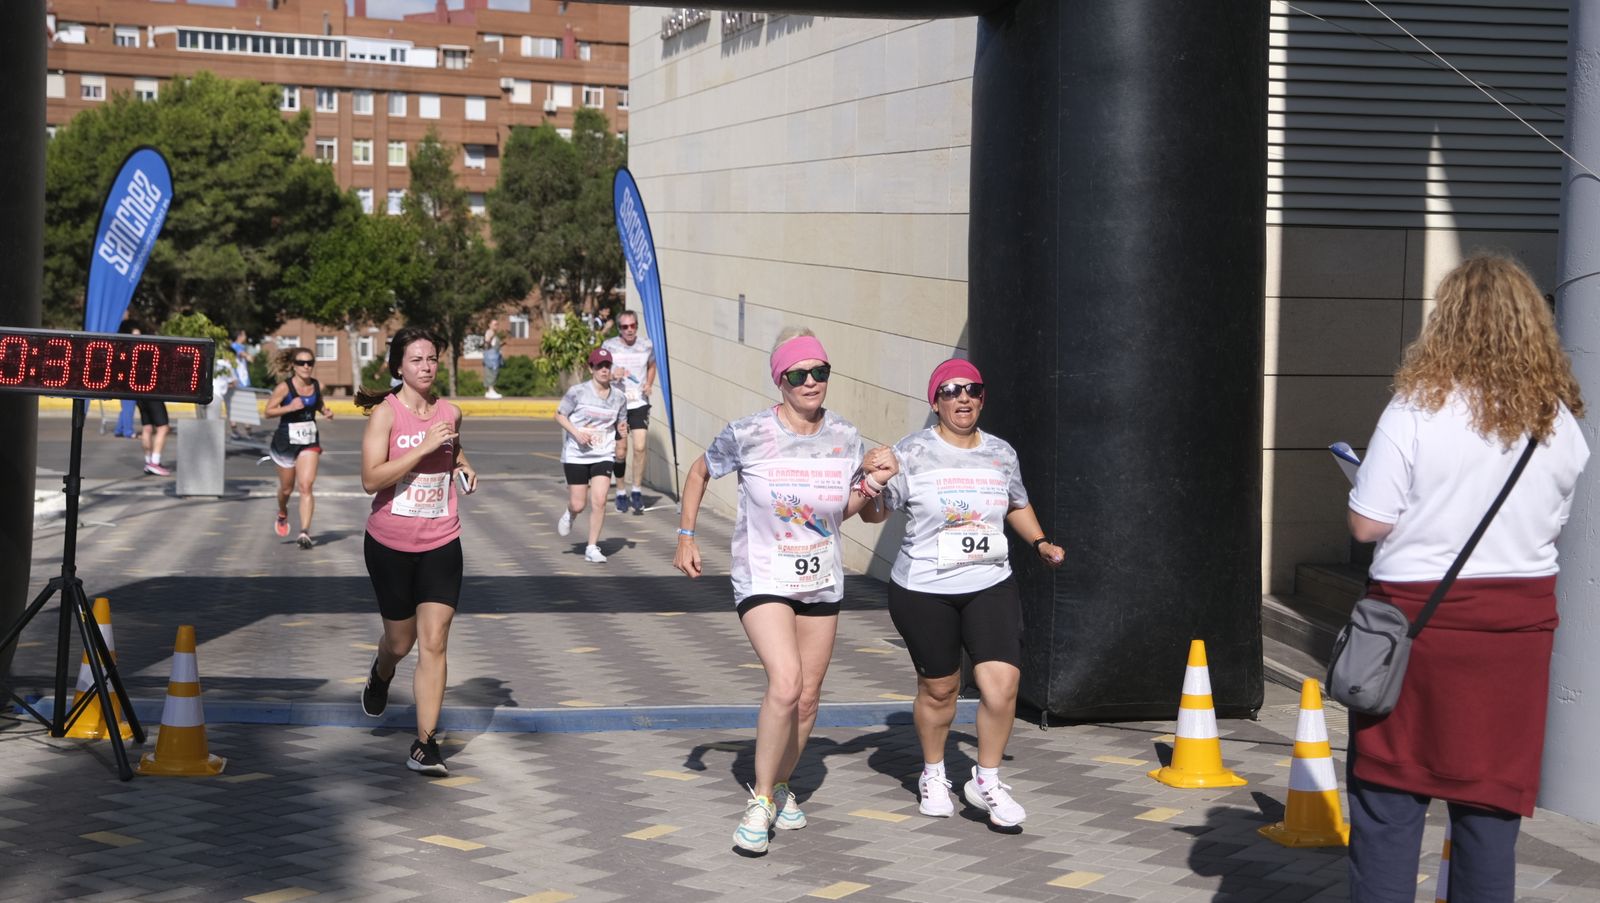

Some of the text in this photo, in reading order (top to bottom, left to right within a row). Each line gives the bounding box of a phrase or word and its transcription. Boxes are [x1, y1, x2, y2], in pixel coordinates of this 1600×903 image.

[405, 486, 445, 503] 1029
[961, 536, 990, 554] 94
[795, 556, 821, 576] 93
